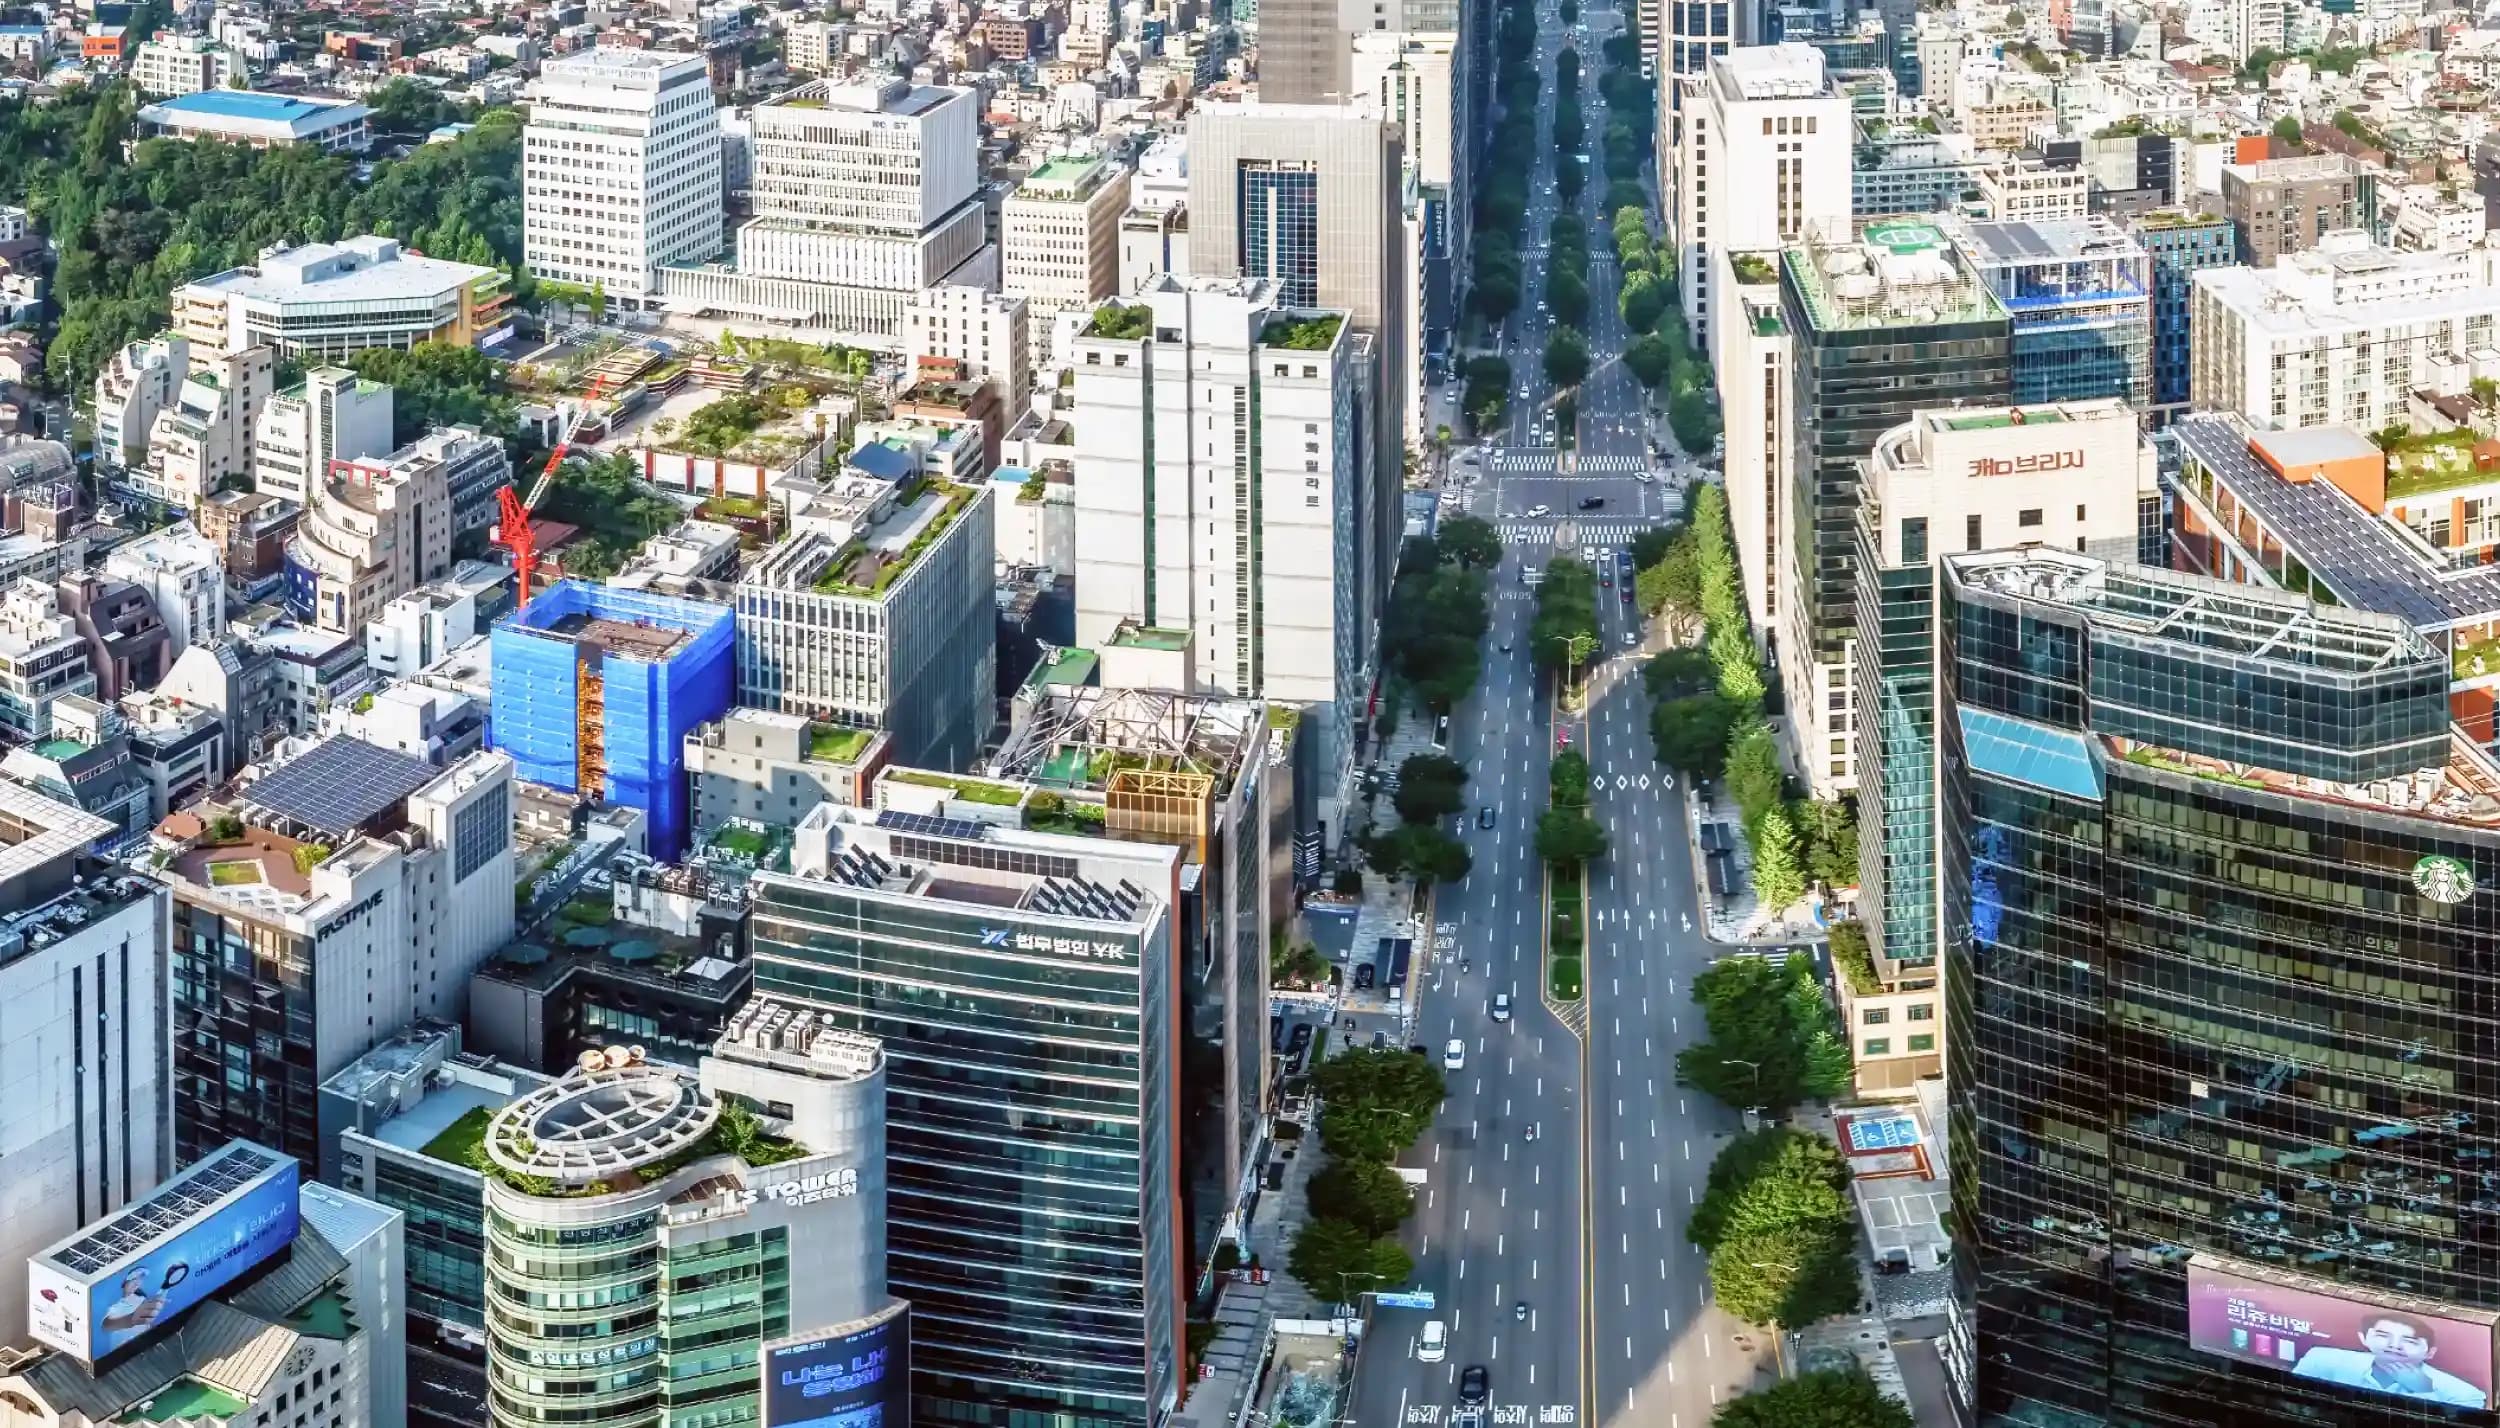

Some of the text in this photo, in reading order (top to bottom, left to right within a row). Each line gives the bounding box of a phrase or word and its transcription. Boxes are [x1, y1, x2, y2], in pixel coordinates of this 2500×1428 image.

[1015, 932, 1125, 960] 법무법인 YK
[1493, 1405, 1529, 1424] 서초역
